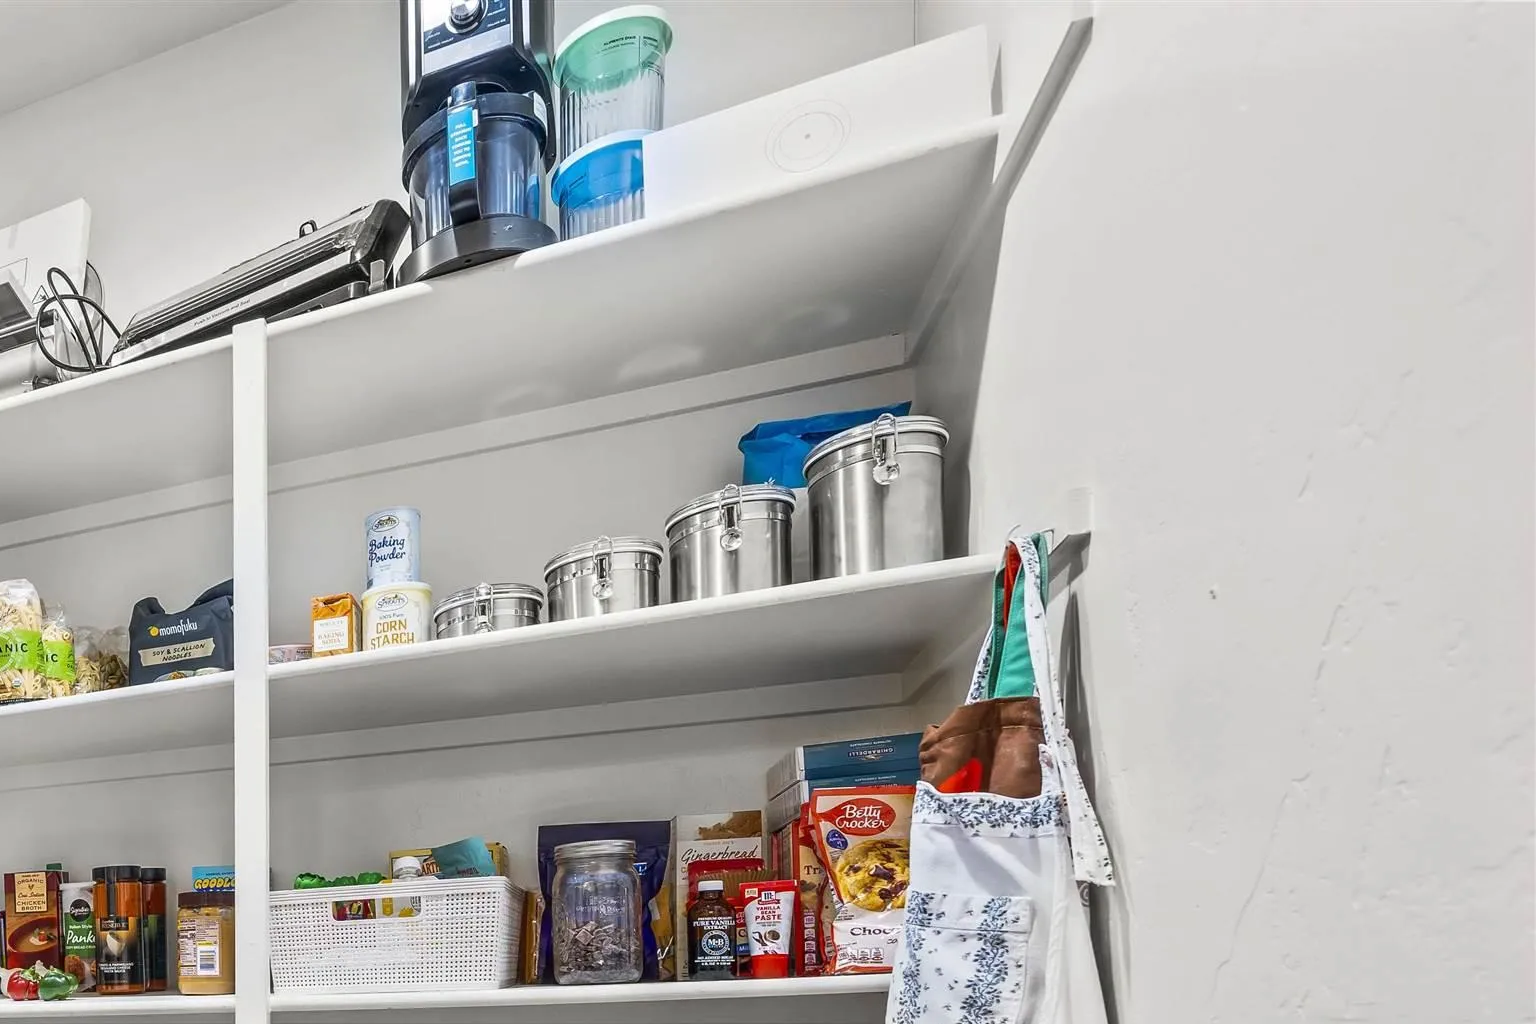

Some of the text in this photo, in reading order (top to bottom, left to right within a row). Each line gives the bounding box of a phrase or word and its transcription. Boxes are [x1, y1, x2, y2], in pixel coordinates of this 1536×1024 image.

[369, 536, 405, 551] Baking
[368, 548, 406, 567] Powder
[159, 618, 198, 636] momofuku
[376, 619, 407, 634] CORN
[173, 643, 206, 654] SCALLION
[371, 632, 414, 650] STARCH
[162, 651, 192, 662] NOODLES
[841, 805, 882, 819] Betty
[835, 816, 889, 829] Crocker
[681, 845, 758, 864] Gingerbread
